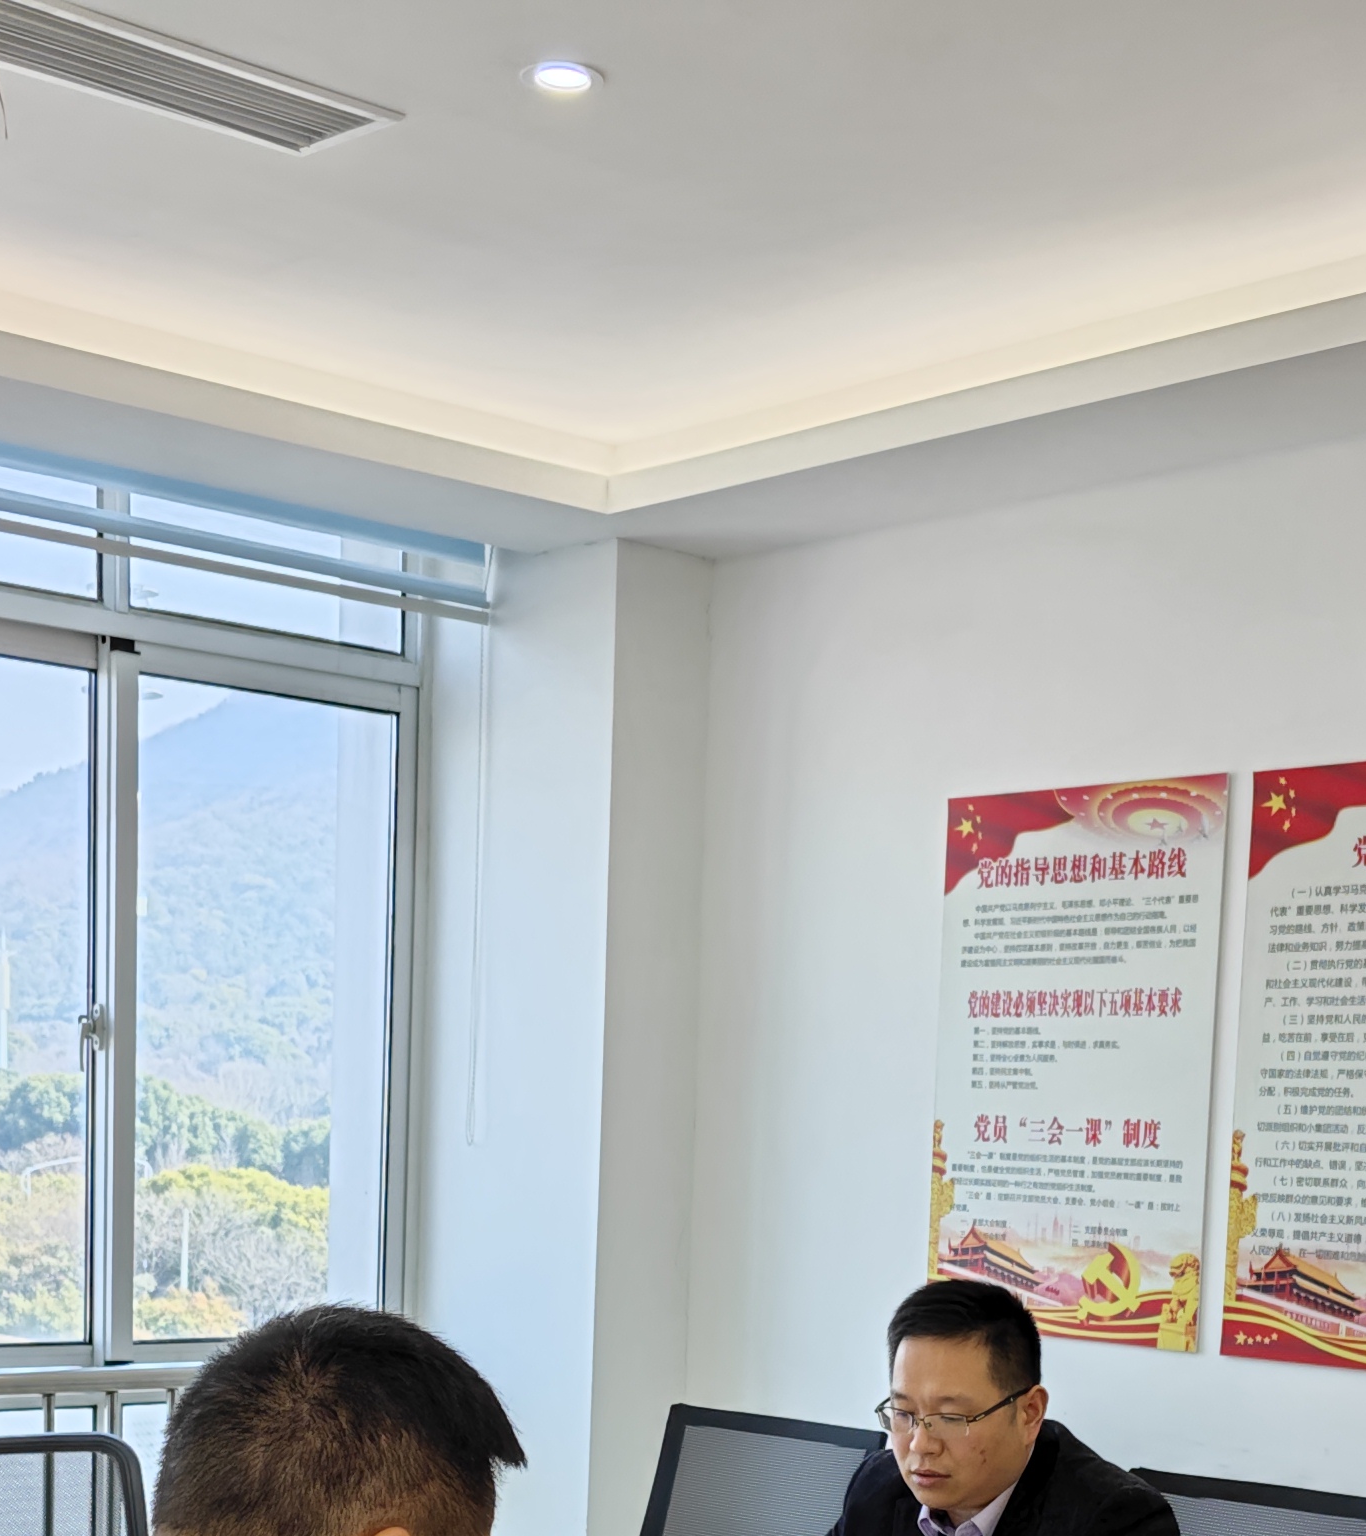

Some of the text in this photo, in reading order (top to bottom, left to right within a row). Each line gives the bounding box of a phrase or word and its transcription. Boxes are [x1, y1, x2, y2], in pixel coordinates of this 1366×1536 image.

[976, 847, 1187, 888] 党的指导思想和基本路线
[968, 987, 1182, 1018] 党的建设必须坚决实现以下五项基本要求
